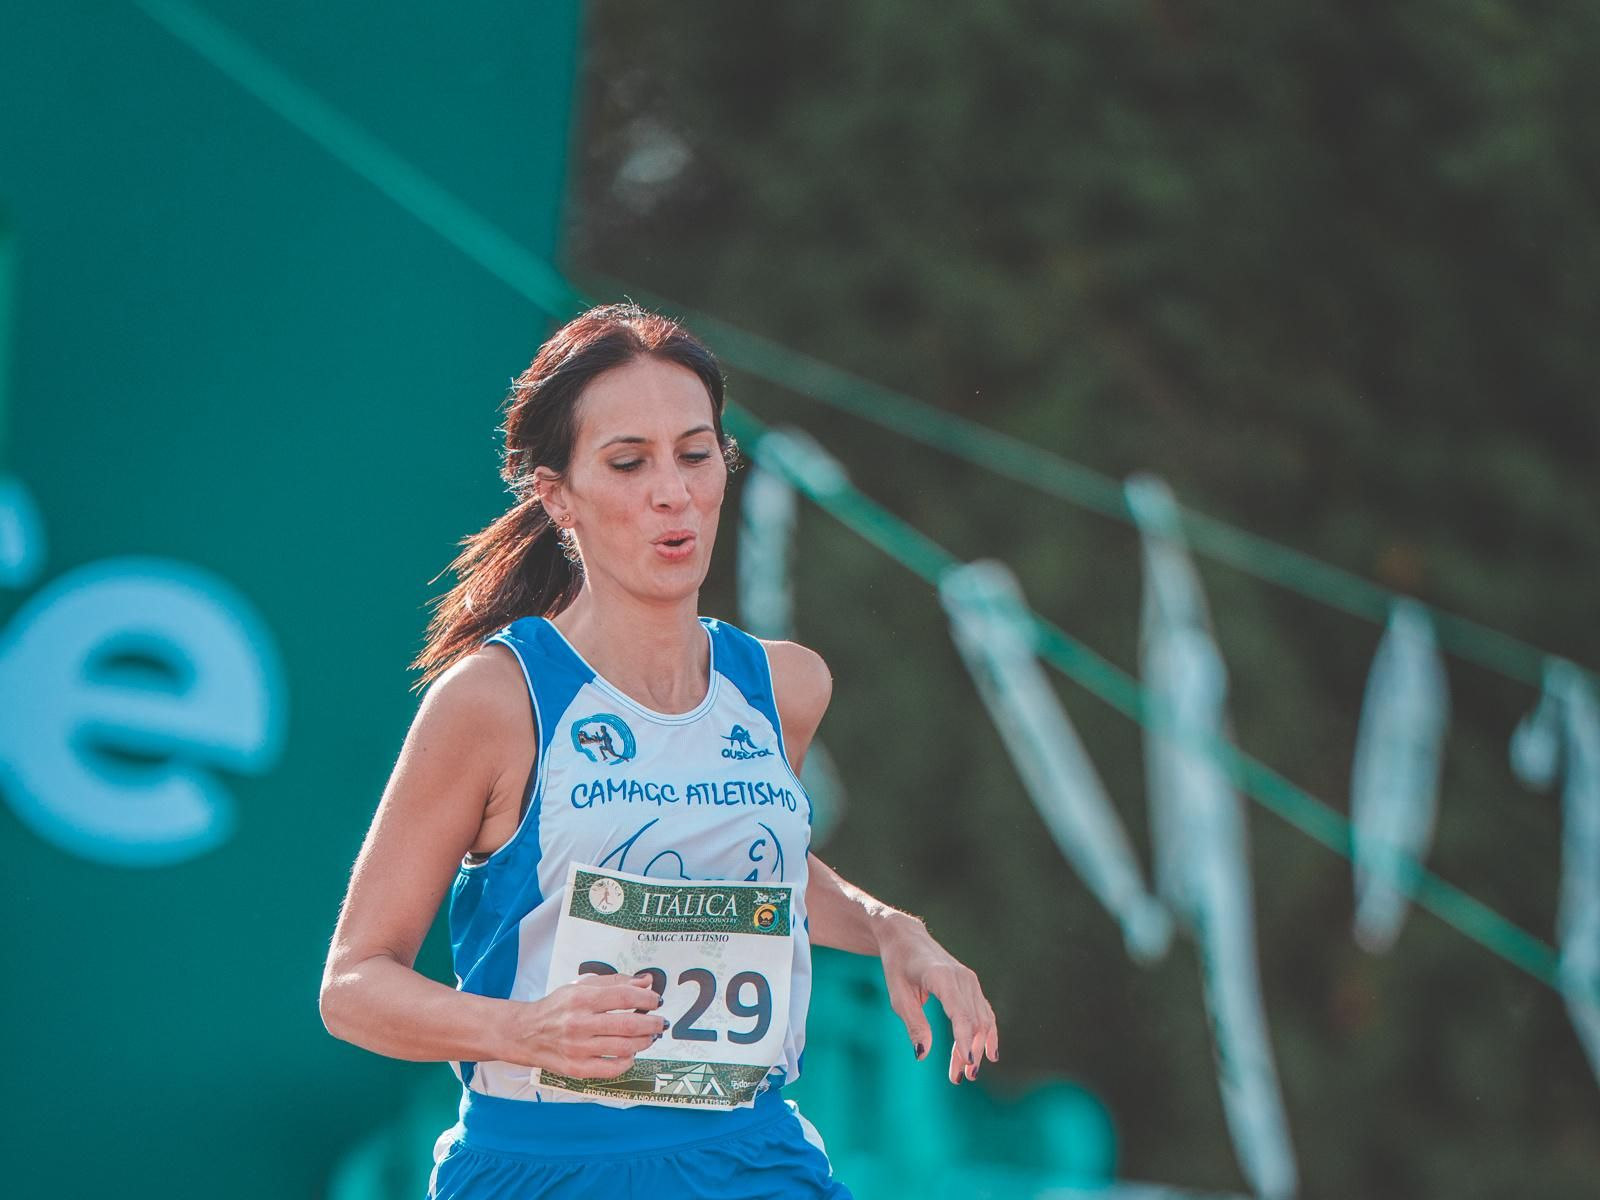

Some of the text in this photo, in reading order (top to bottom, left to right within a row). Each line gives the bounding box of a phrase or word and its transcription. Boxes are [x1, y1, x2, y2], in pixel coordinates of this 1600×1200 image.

[571, 778, 797, 812] CAMAGC ATLETISMO
[639, 889, 739, 917] ITÁLICA
[677, 934, 730, 943] ATLETISMO
[578, 960, 773, 1044] 29
[633, 1093, 675, 1104] ANDALUZA
[691, 1098, 731, 1106] ATLETISMO
